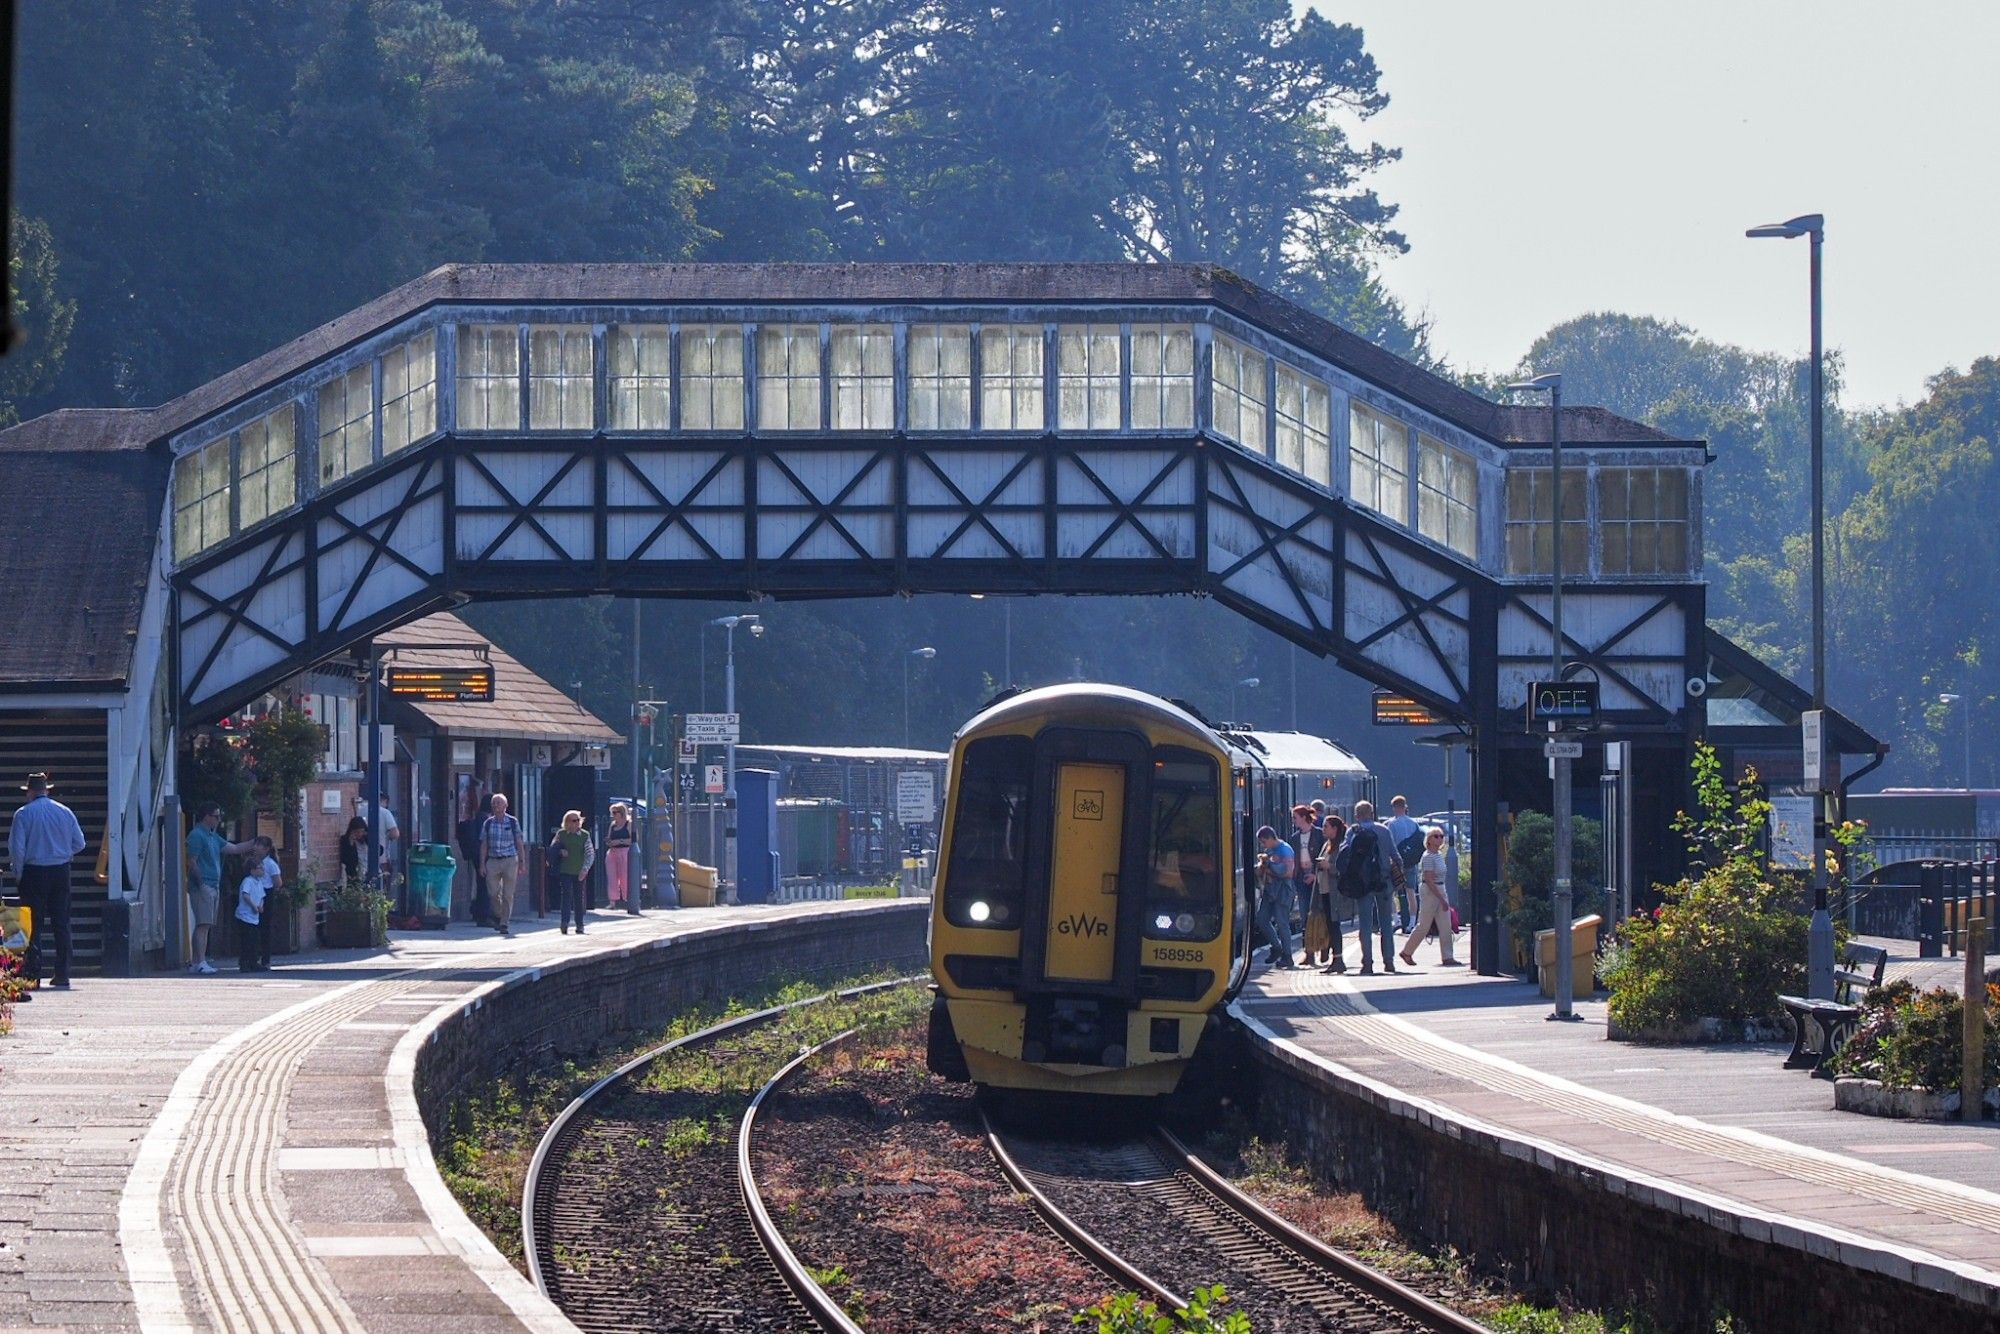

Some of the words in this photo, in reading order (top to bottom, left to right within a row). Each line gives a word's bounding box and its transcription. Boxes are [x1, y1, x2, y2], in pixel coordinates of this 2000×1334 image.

[460, 692, 483, 700] Platform
[1540, 690, 1587, 713] OFF
[697, 715, 712, 723] Way
[680, 779, 695, 787] 4/5
[1058, 912, 1108, 938] GWR
[1153, 948, 1204, 962] 158958
